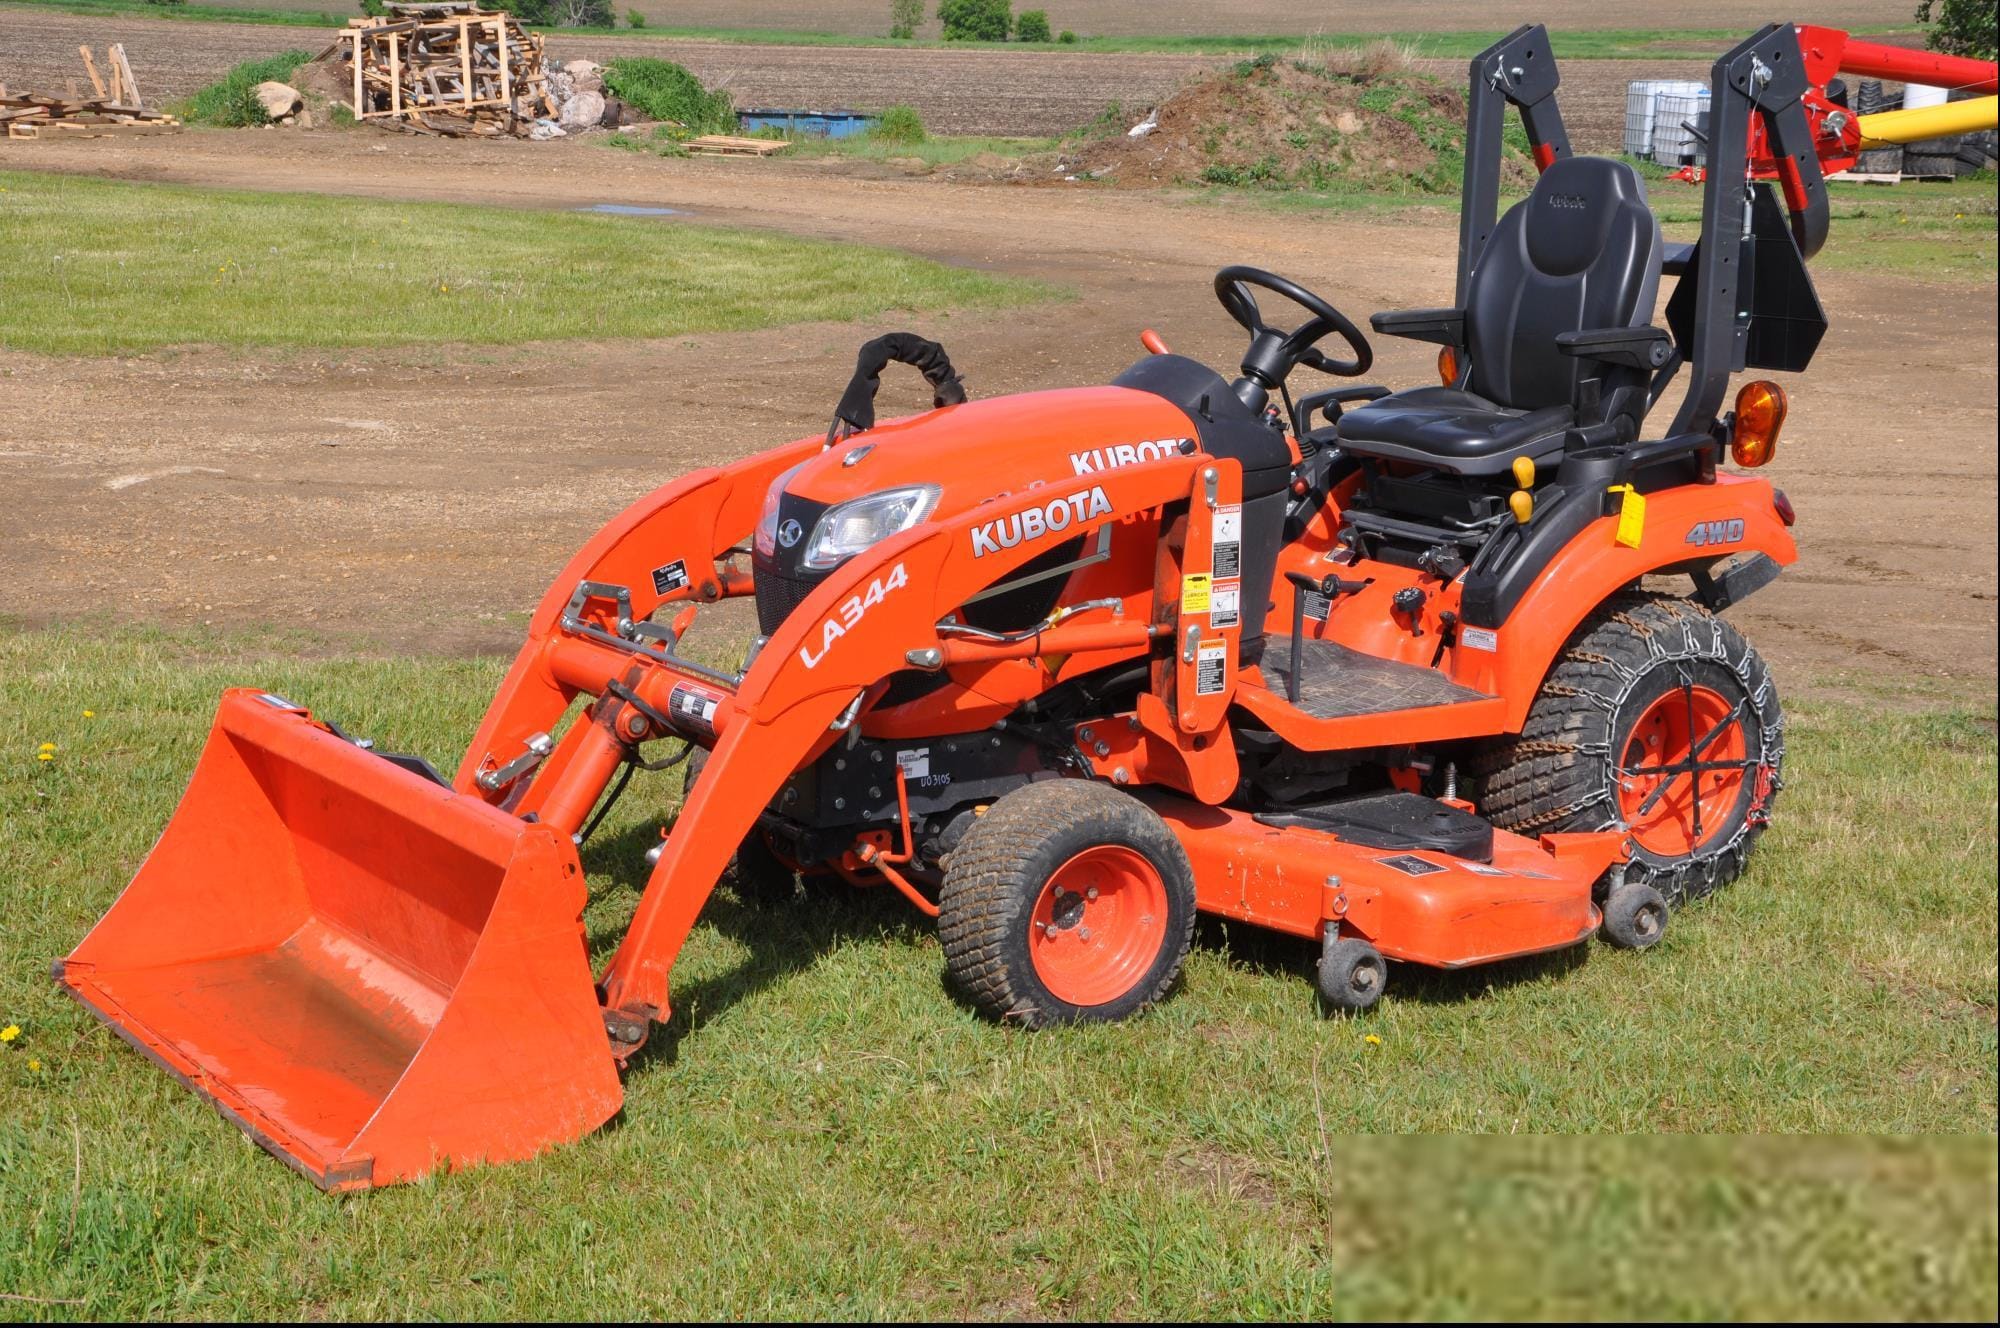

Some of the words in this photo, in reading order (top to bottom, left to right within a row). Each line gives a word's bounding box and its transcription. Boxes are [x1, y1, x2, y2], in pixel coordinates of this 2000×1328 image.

[970, 485, 1113, 558] KUBOTA
[1685, 518, 1745, 546] 4WD
[799, 562, 909, 669] LA344
